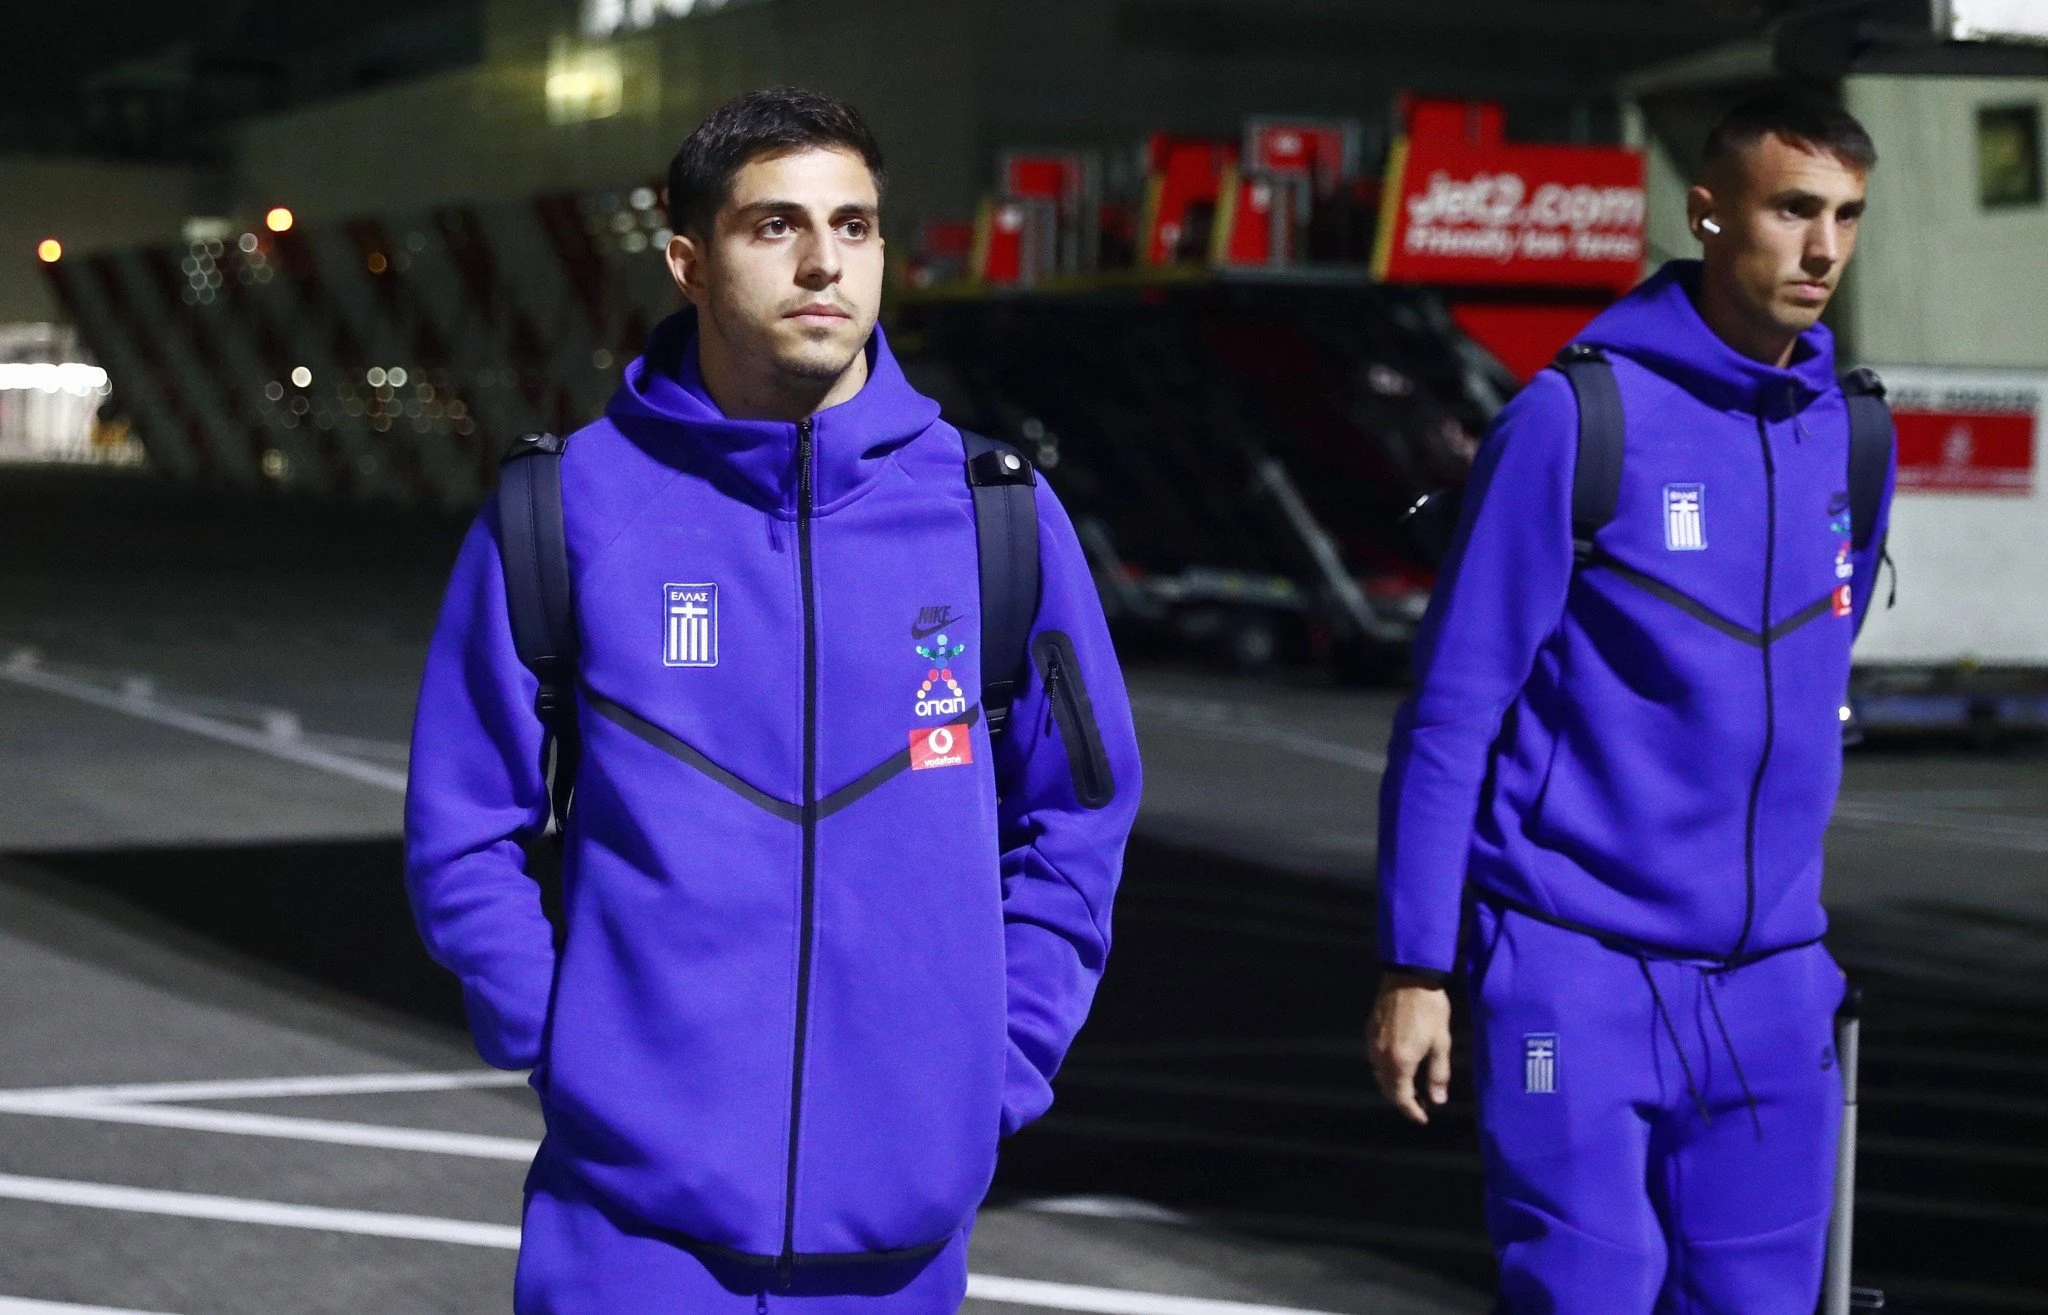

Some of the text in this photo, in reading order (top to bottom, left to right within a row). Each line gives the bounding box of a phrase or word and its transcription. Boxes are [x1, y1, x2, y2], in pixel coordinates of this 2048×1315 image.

[1405, 171, 1645, 226] Jet2.com
[671, 591, 708, 602] ΕΛΛΑΣ
[918, 605, 952, 624] NIKE
[923, 755, 963, 768] vodafone
